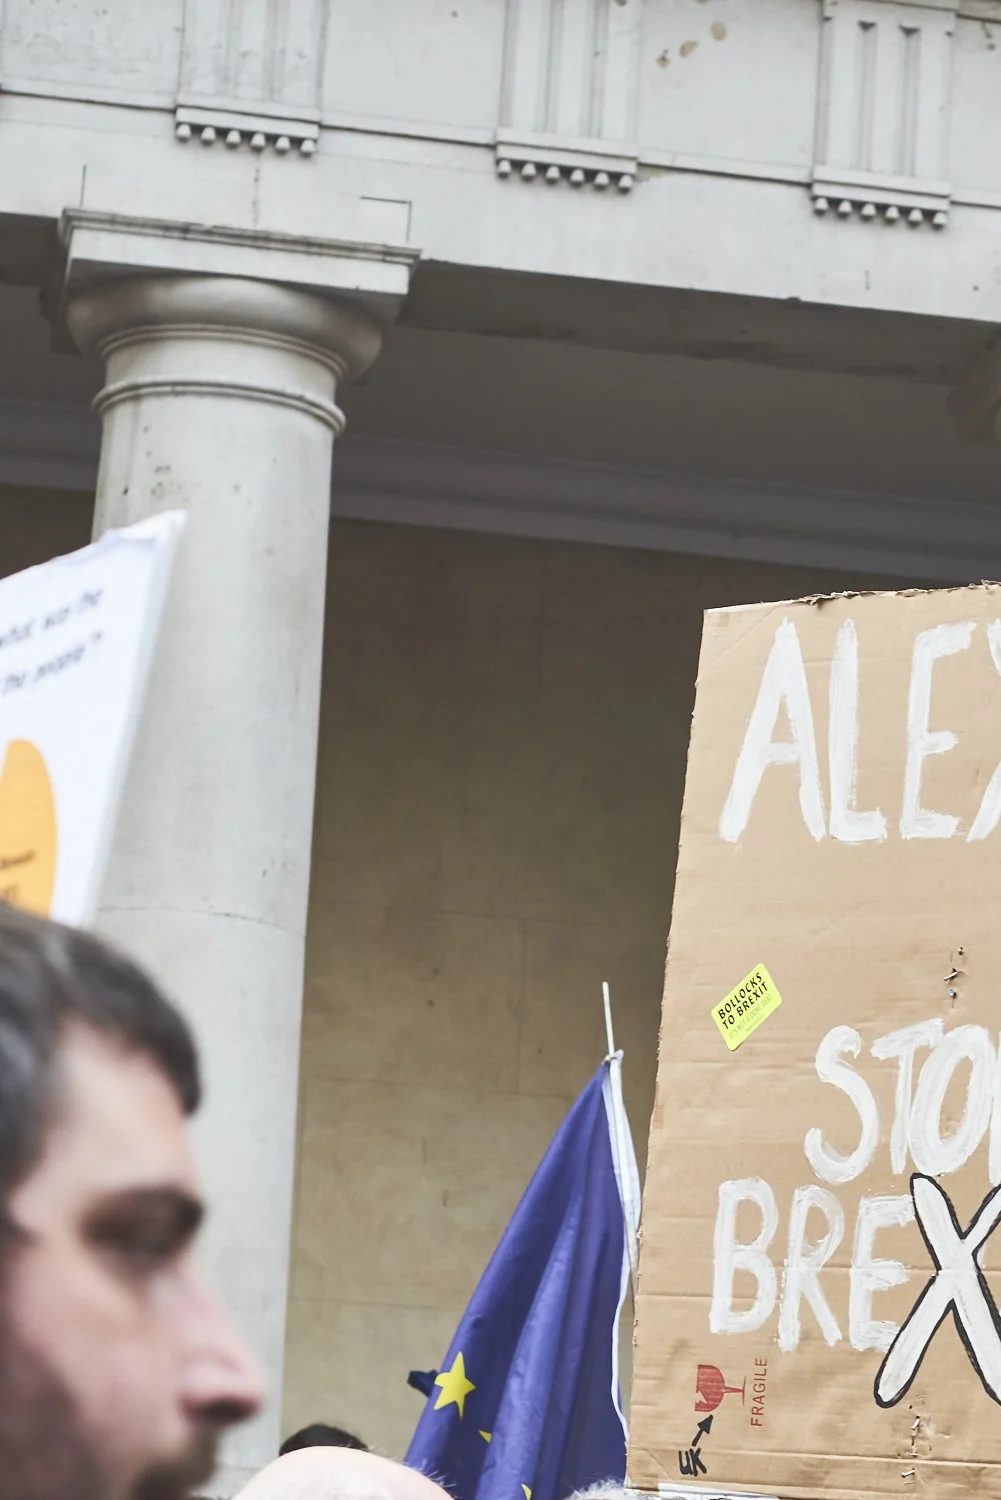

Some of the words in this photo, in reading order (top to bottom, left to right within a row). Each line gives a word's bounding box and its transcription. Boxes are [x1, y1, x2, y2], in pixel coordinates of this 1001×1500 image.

[718, 972, 762, 1020] BOLLOCKS
[722, 1014, 735, 1030] TO
[736, 981, 768, 1017] BREXIT
[751, 1358, 768, 1427] FRAGILE
[678, 1447, 708, 1477] UK
